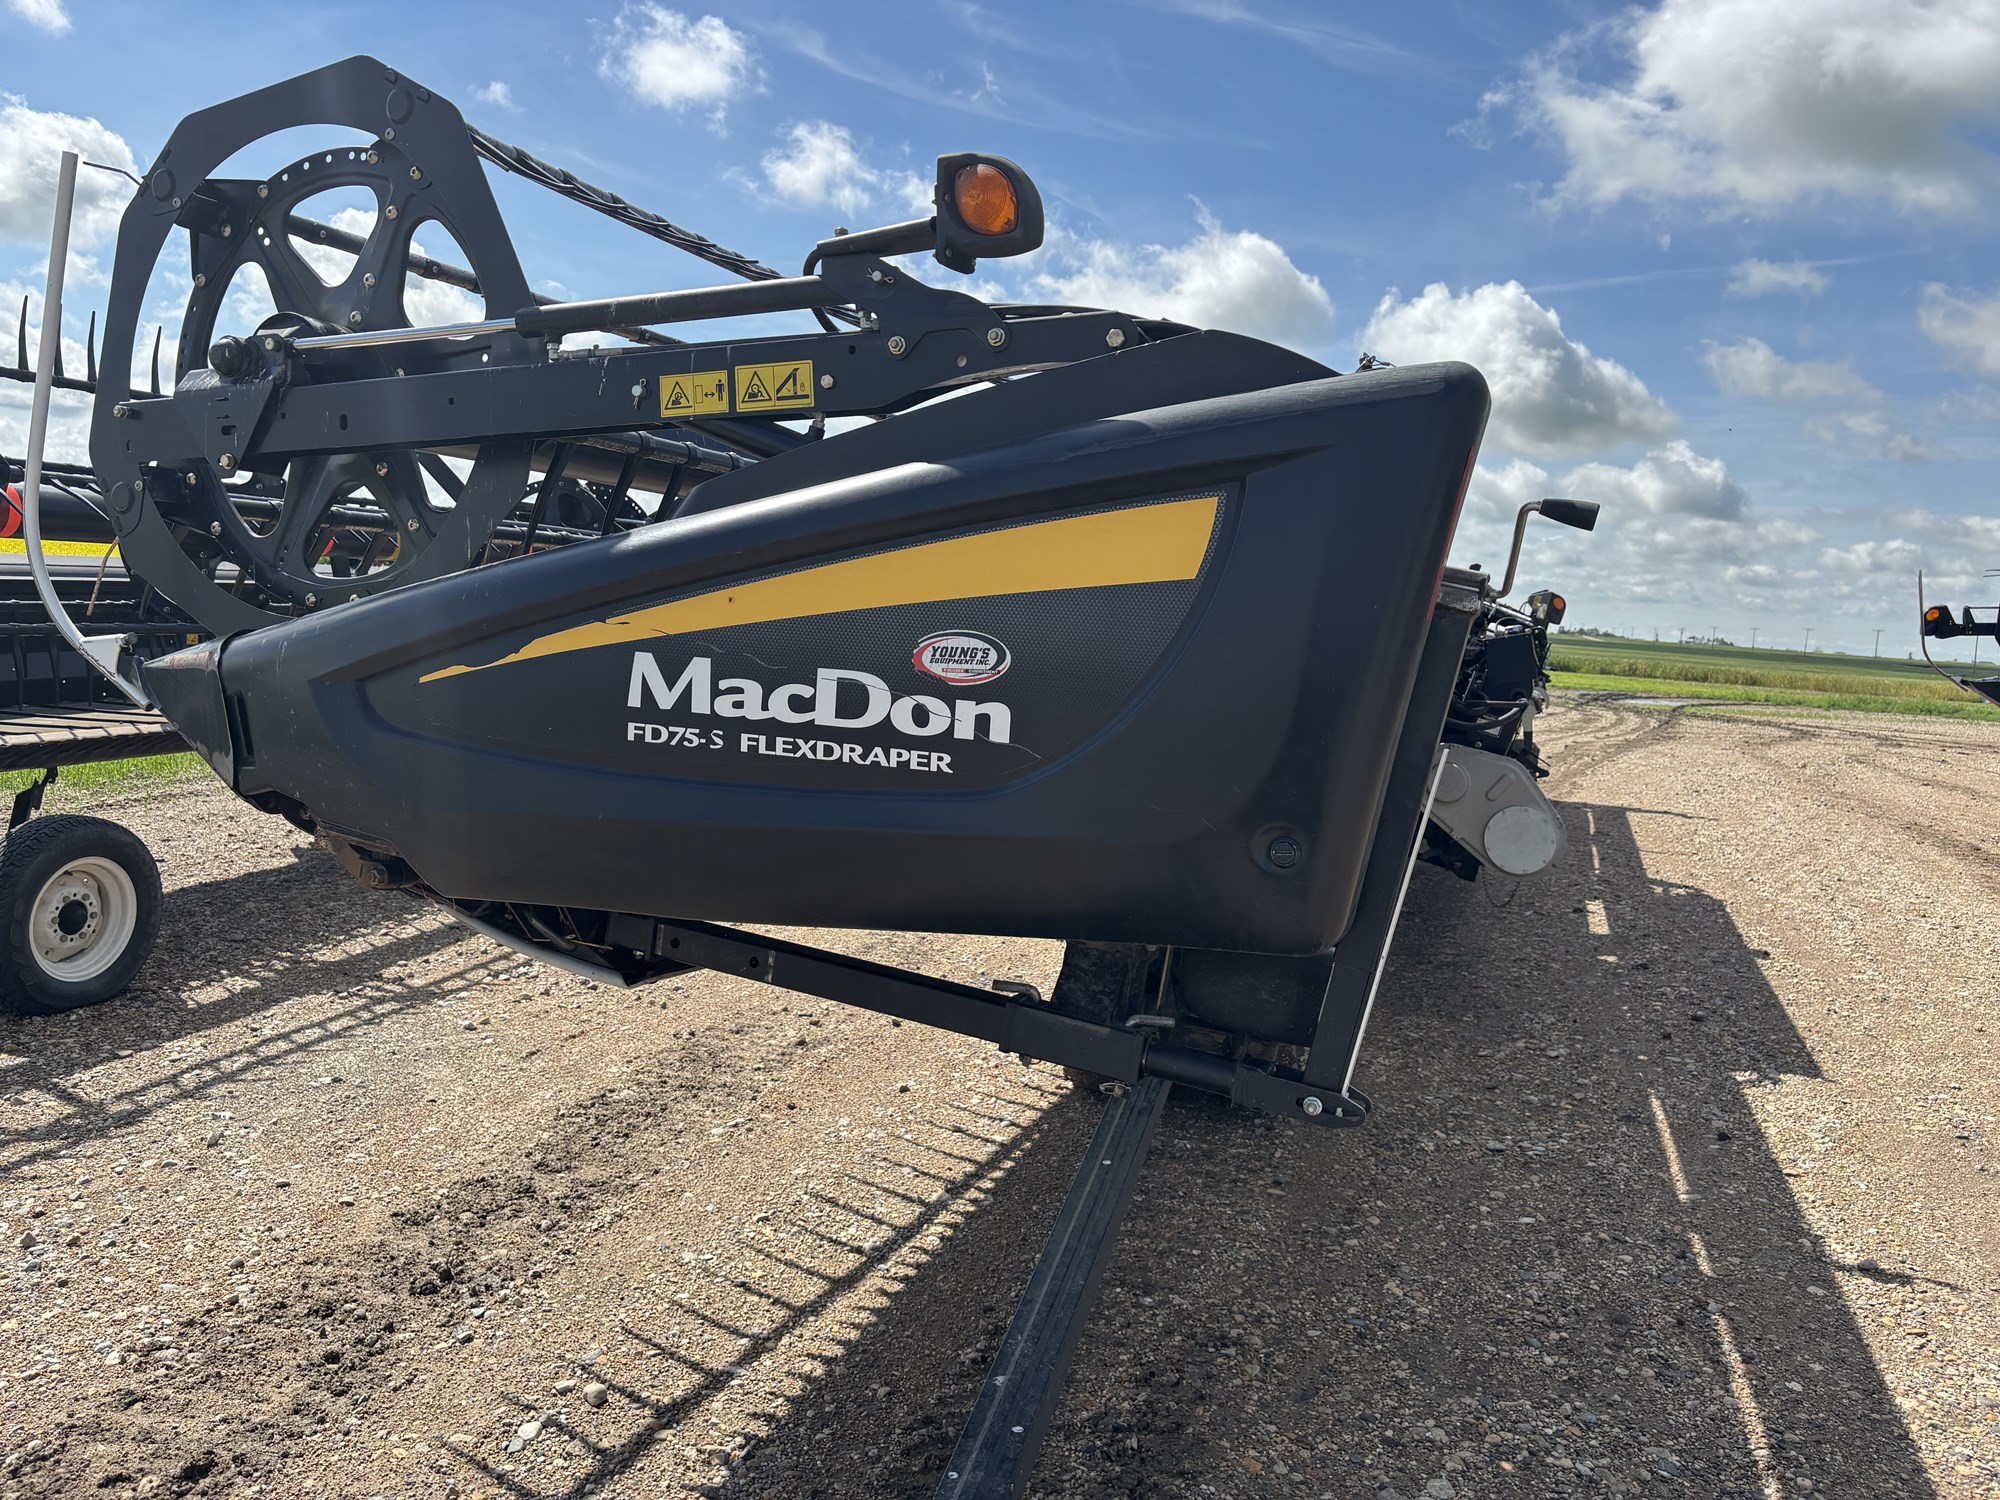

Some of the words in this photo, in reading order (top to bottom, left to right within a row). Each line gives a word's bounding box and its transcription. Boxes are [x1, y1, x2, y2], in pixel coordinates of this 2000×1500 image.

[929, 658, 974, 666] EQUIPMENT
[930, 646, 991, 660] YOUNG'S
[627, 651, 1012, 744] MacDon
[627, 722, 724, 749] FD75-S
[740, 733, 954, 774] FLEXDRAPER
